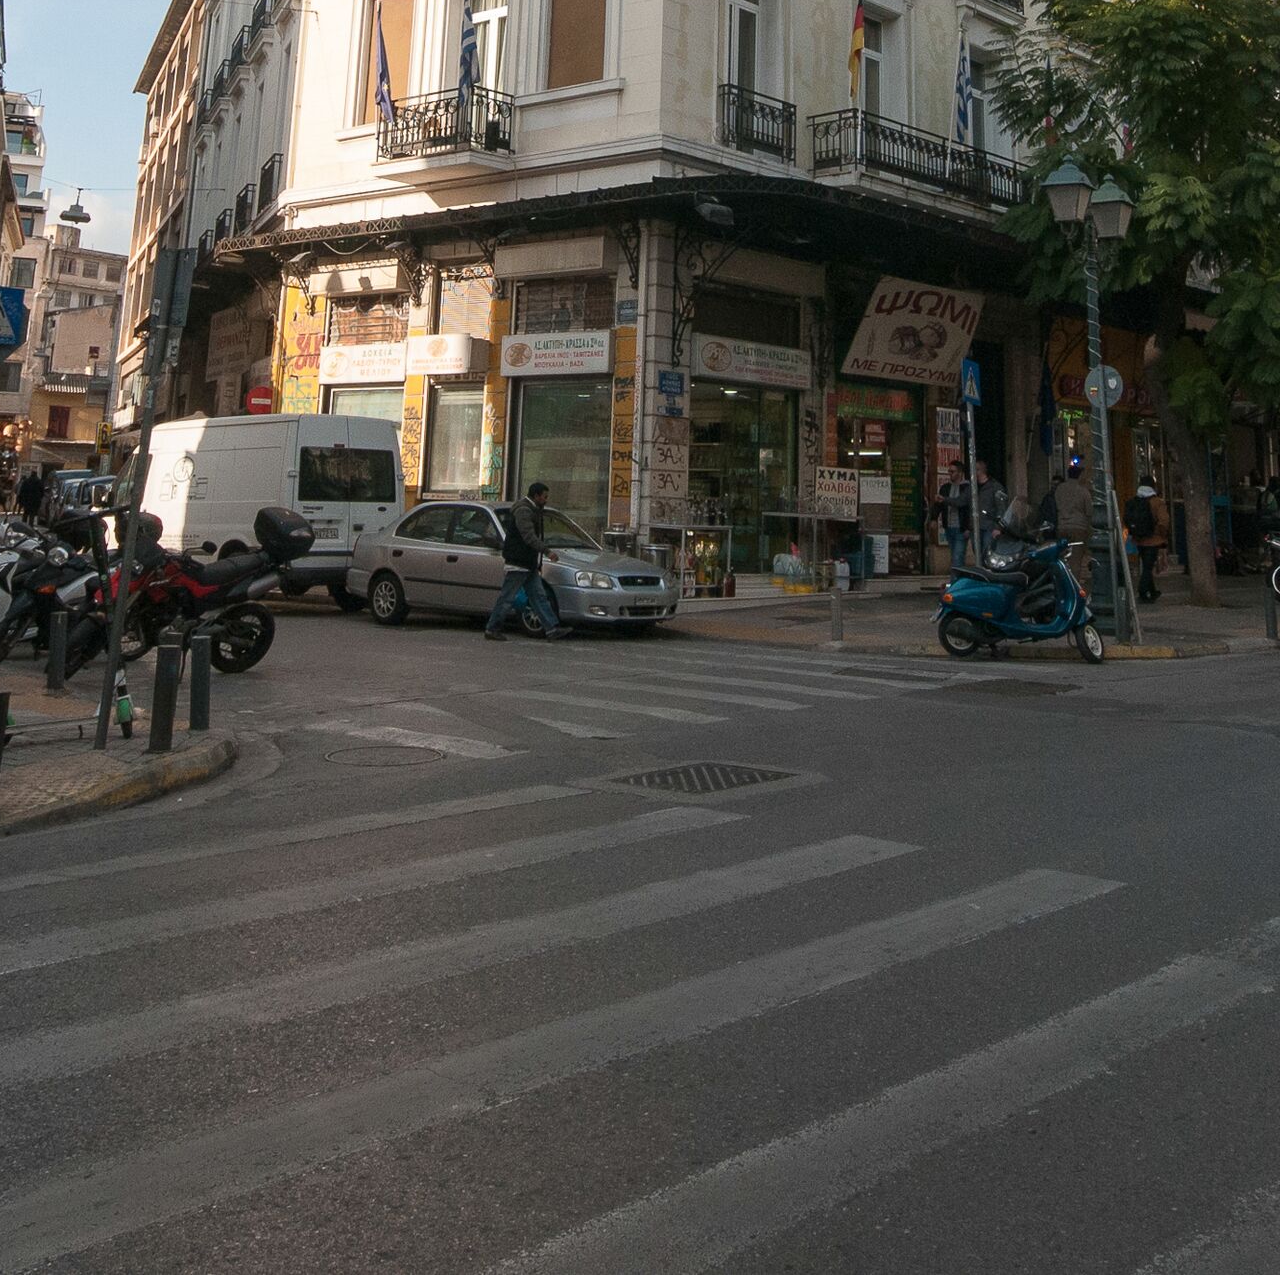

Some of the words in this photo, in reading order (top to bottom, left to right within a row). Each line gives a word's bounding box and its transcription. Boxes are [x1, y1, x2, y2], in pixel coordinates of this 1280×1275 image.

[875, 290, 977, 335] ΨΩΜΙ
[851, 358, 879, 372] ΜΕ
[881, 362, 956, 383] ΠΡΟΖΥΜΙ
[818, 469, 856, 482] ΧΥΜΑ
[818, 481, 857, 494] Χαλβάς
